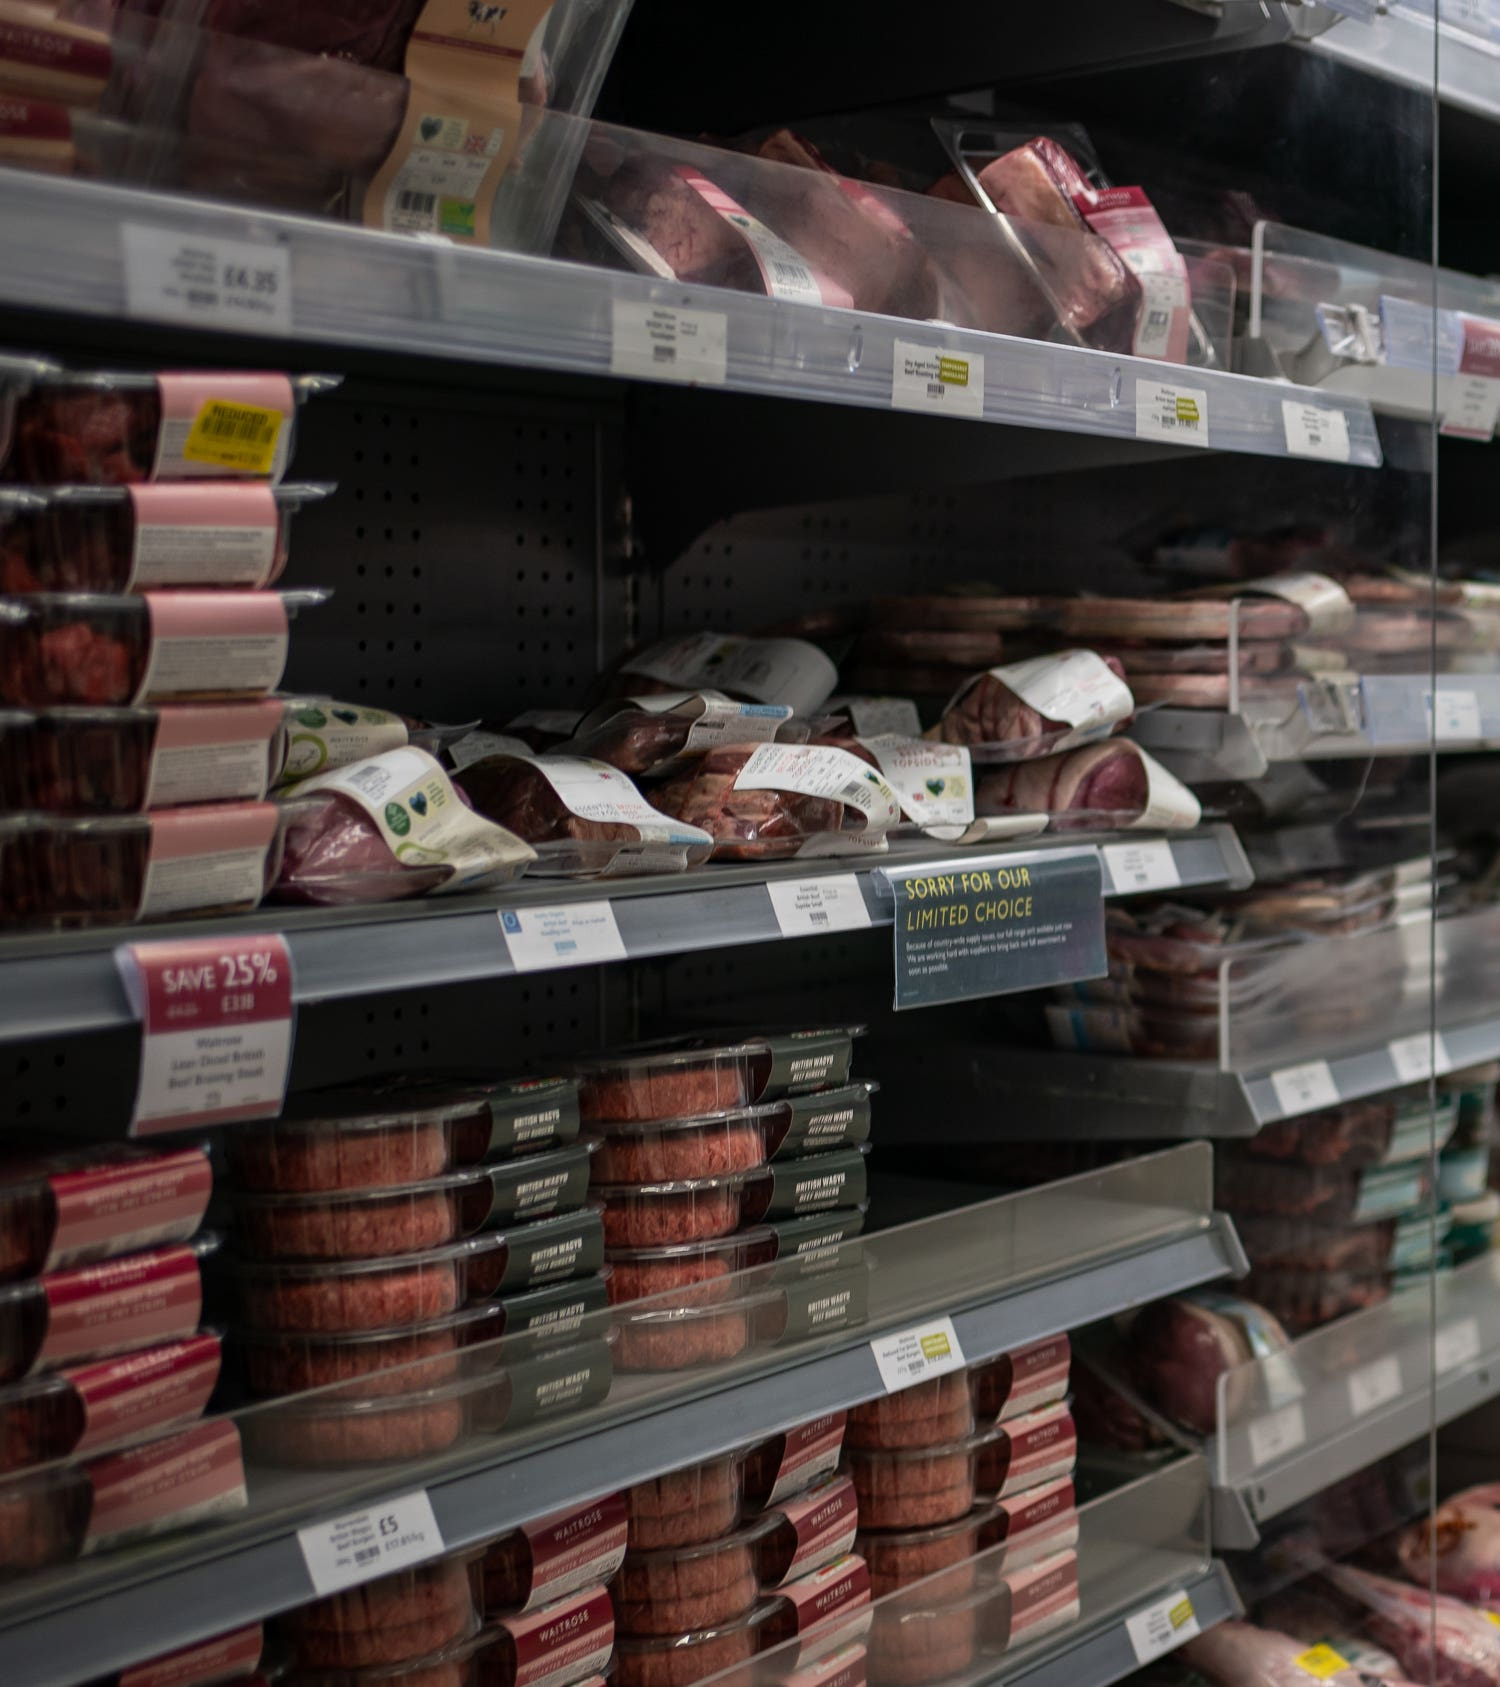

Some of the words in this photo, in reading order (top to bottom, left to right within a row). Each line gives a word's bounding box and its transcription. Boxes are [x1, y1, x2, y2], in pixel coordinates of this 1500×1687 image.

[212, 405, 269, 425] REDUCED
[905, 876, 955, 900] SORRY
[961, 871, 993, 894] FOR
[998, 867, 1031, 890] OUR
[907, 904, 968, 931] LIMITED
[975, 896, 1032, 922] CHOICE
[906, 941, 926, 952] Because
[927, 939, 933, 949] of
[906, 954, 916, 963] We
[917, 954, 925, 962] are
[926, 951, 946, 962] working
[946, 948, 957, 958] hard
[958, 946, 969, 956] with
[162, 966, 216, 994] SAVE
[218, 952, 278, 988] 25%
[196, 1036, 242, 1049] Waitrose
[232, 1049, 266, 1062] British
[791, 1058, 814, 1072] BRITISH
[814, 1054, 833, 1068] WAGYU
[168, 1076, 193, 1090] Beef
[513, 1113, 538, 1130] BRITISH
[538, 1108, 560, 1123] WAGYU
[809, 1113, 833, 1126] BRITISH
[833, 1109, 853, 1122] WAGYU
[517, 1180, 543, 1197] BRITISH
[544, 1172, 568, 1188] WAGYU
[796, 1178, 821, 1194] BRITISH
[822, 1172, 845, 1187] WAGYU
[531, 1246, 558, 1263] BRITISH
[558, 1237, 582, 1254] WAGYU
[797, 1237, 821, 1253] BRITISH
[808, 1298, 830, 1315] BRITISH
[830, 1290, 850, 1306] WAGYU
[529, 1311, 558, 1328] BRITISH
[559, 1302, 584, 1318] WAGYU
[536, 1379, 564, 1397] BRITISH
[565, 1368, 590, 1385] WAGYU
[801, 1414, 833, 1440] WAITROSE
[1027, 1424, 1059, 1444] WAITROSE
[811, 1498, 842, 1526] WAITROSE
[379, 1515, 398, 1536] £5
[554, 1509, 603, 1541] WAITROSE
[816, 1577, 852, 1609] WAITROSE
[539, 1609, 590, 1642] WAITROSE
